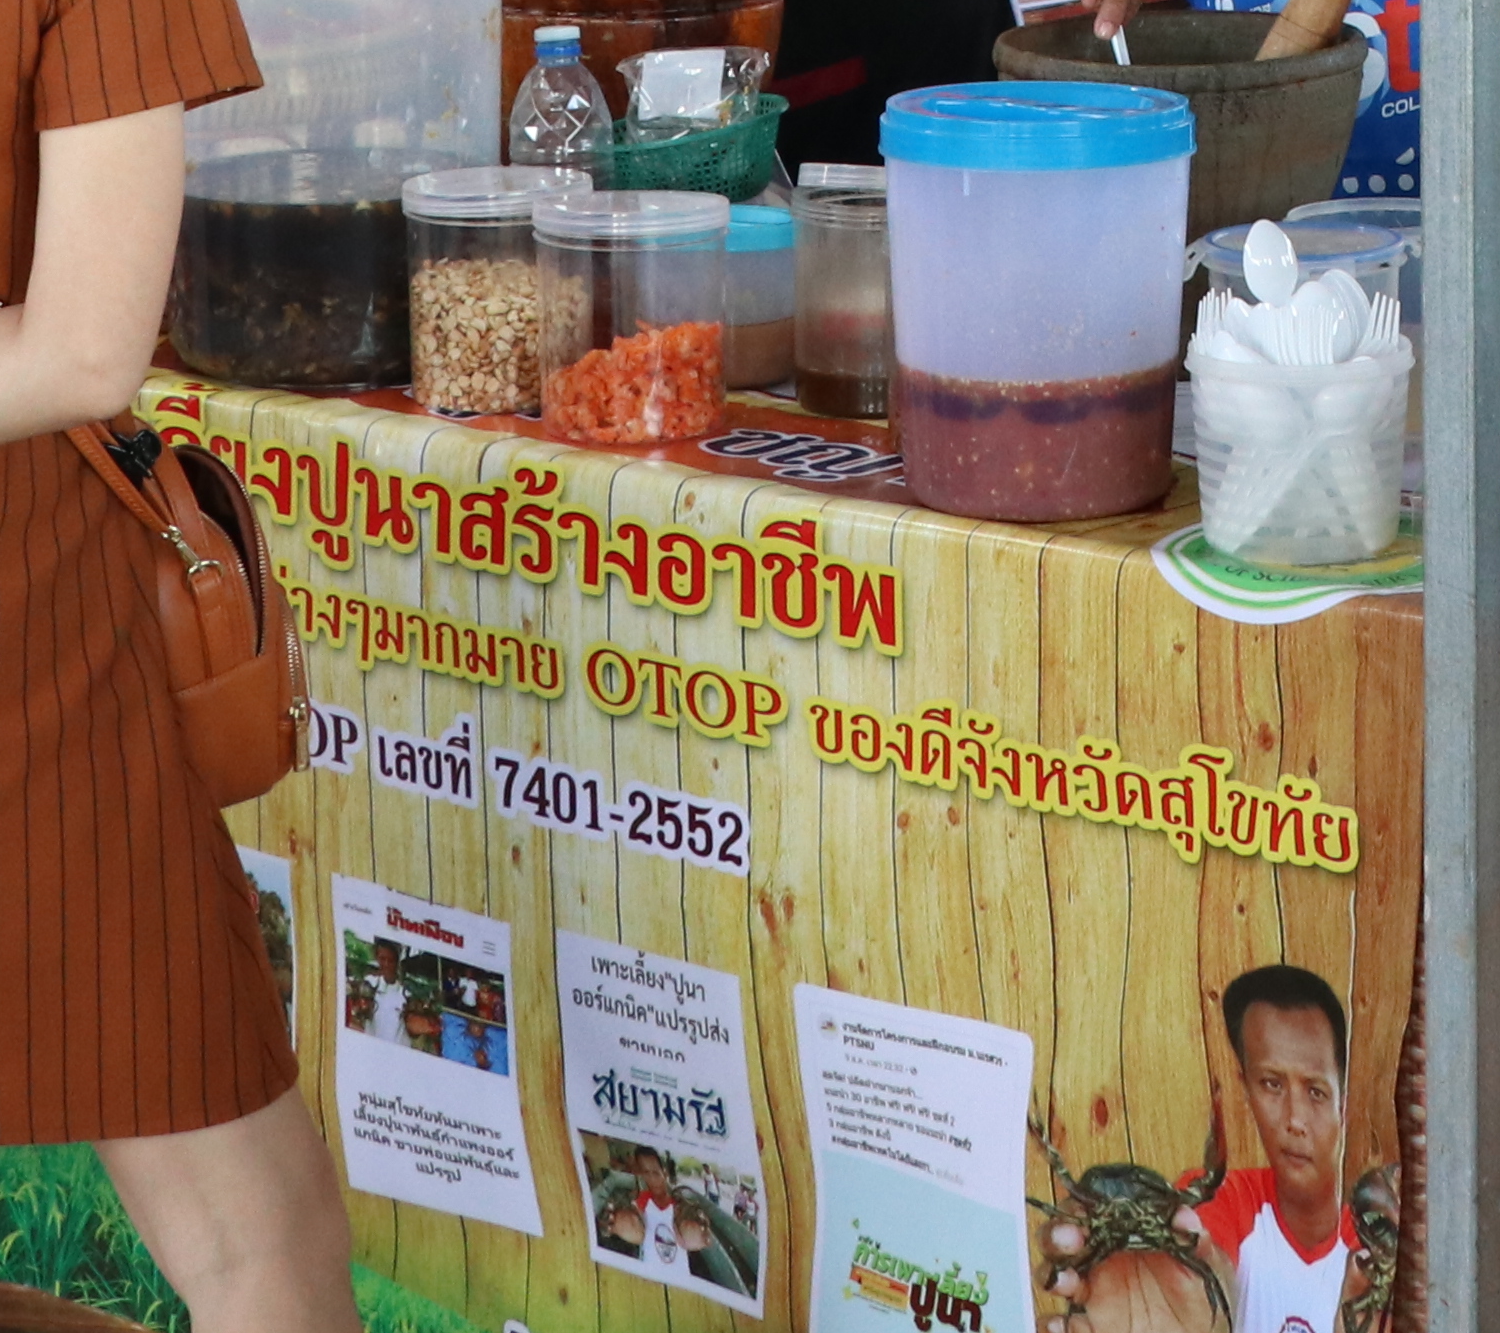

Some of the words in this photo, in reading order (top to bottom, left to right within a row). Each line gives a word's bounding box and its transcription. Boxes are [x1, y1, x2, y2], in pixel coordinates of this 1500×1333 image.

[1380, 95, 1421, 119] COL
[377, 723, 473, 799] เลขที่
[494, 757, 745, 869] 7401-2552
[588, 649, 784, 738] OTOP
[809, 703, 1353, 865] ของดีจังหวัดสุโขทัย
[843, 1035, 876, 1051] PTSNU
